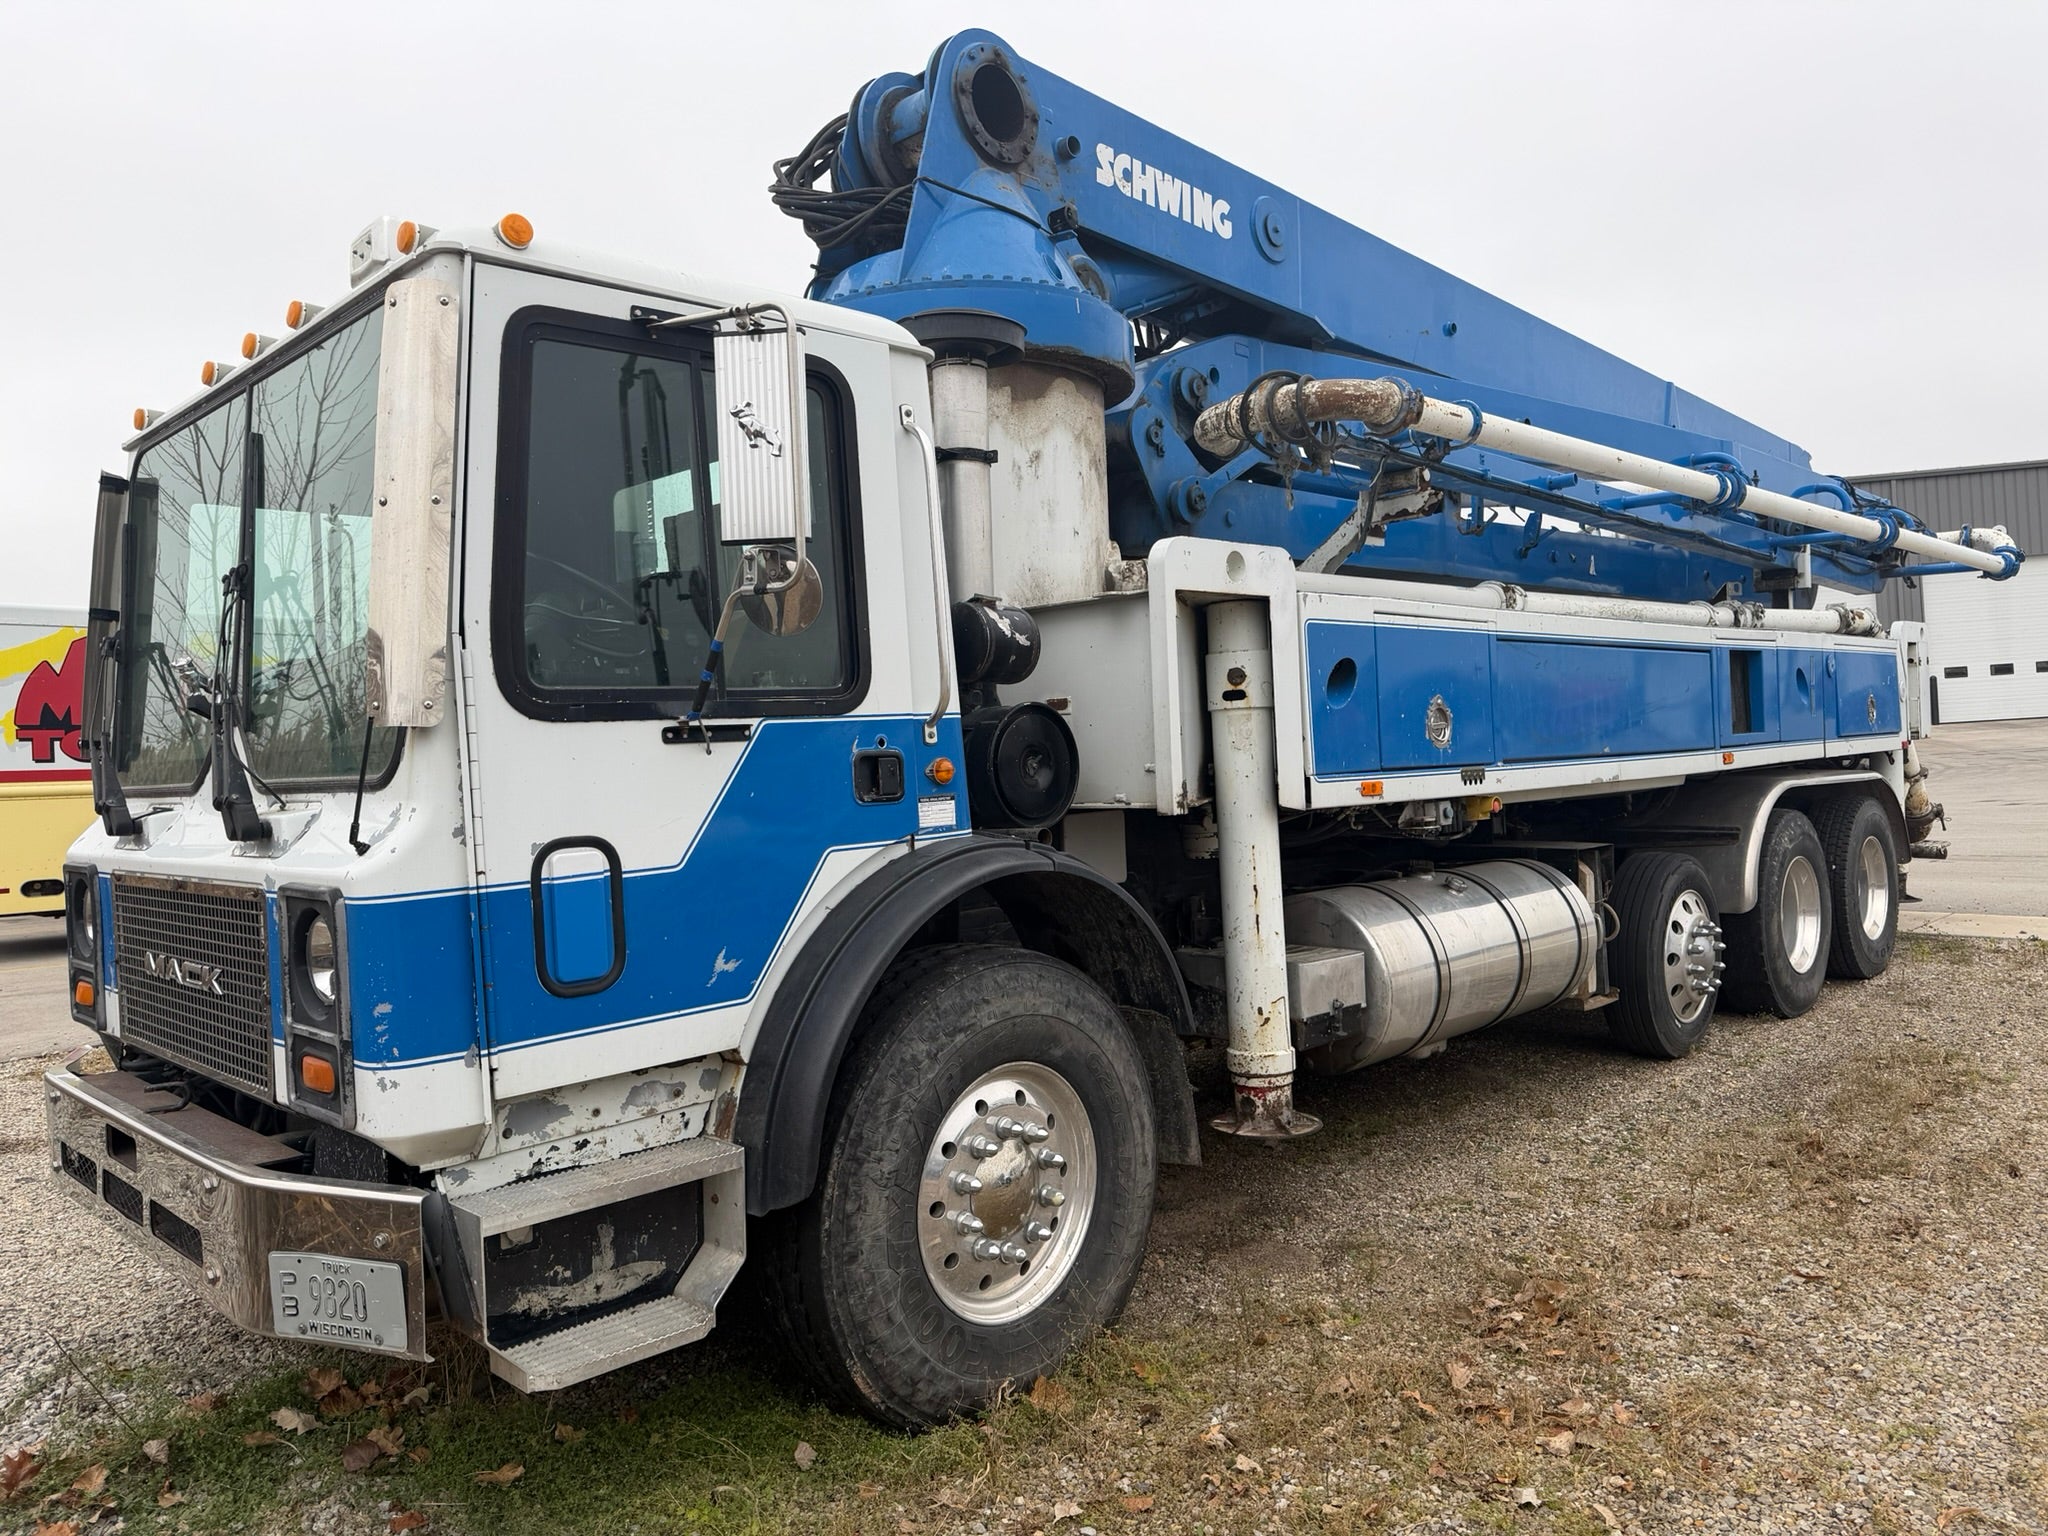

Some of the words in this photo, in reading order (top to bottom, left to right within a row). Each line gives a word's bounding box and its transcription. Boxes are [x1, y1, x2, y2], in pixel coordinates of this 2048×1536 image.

[1096, 143, 1232, 240] SCHWING
[144, 951, 225, 996] MACK
[321, 1262, 351, 1275] TRUCK
[309, 1275, 368, 1323] 9820
[309, 1322, 373, 1341] WISCONSIN
